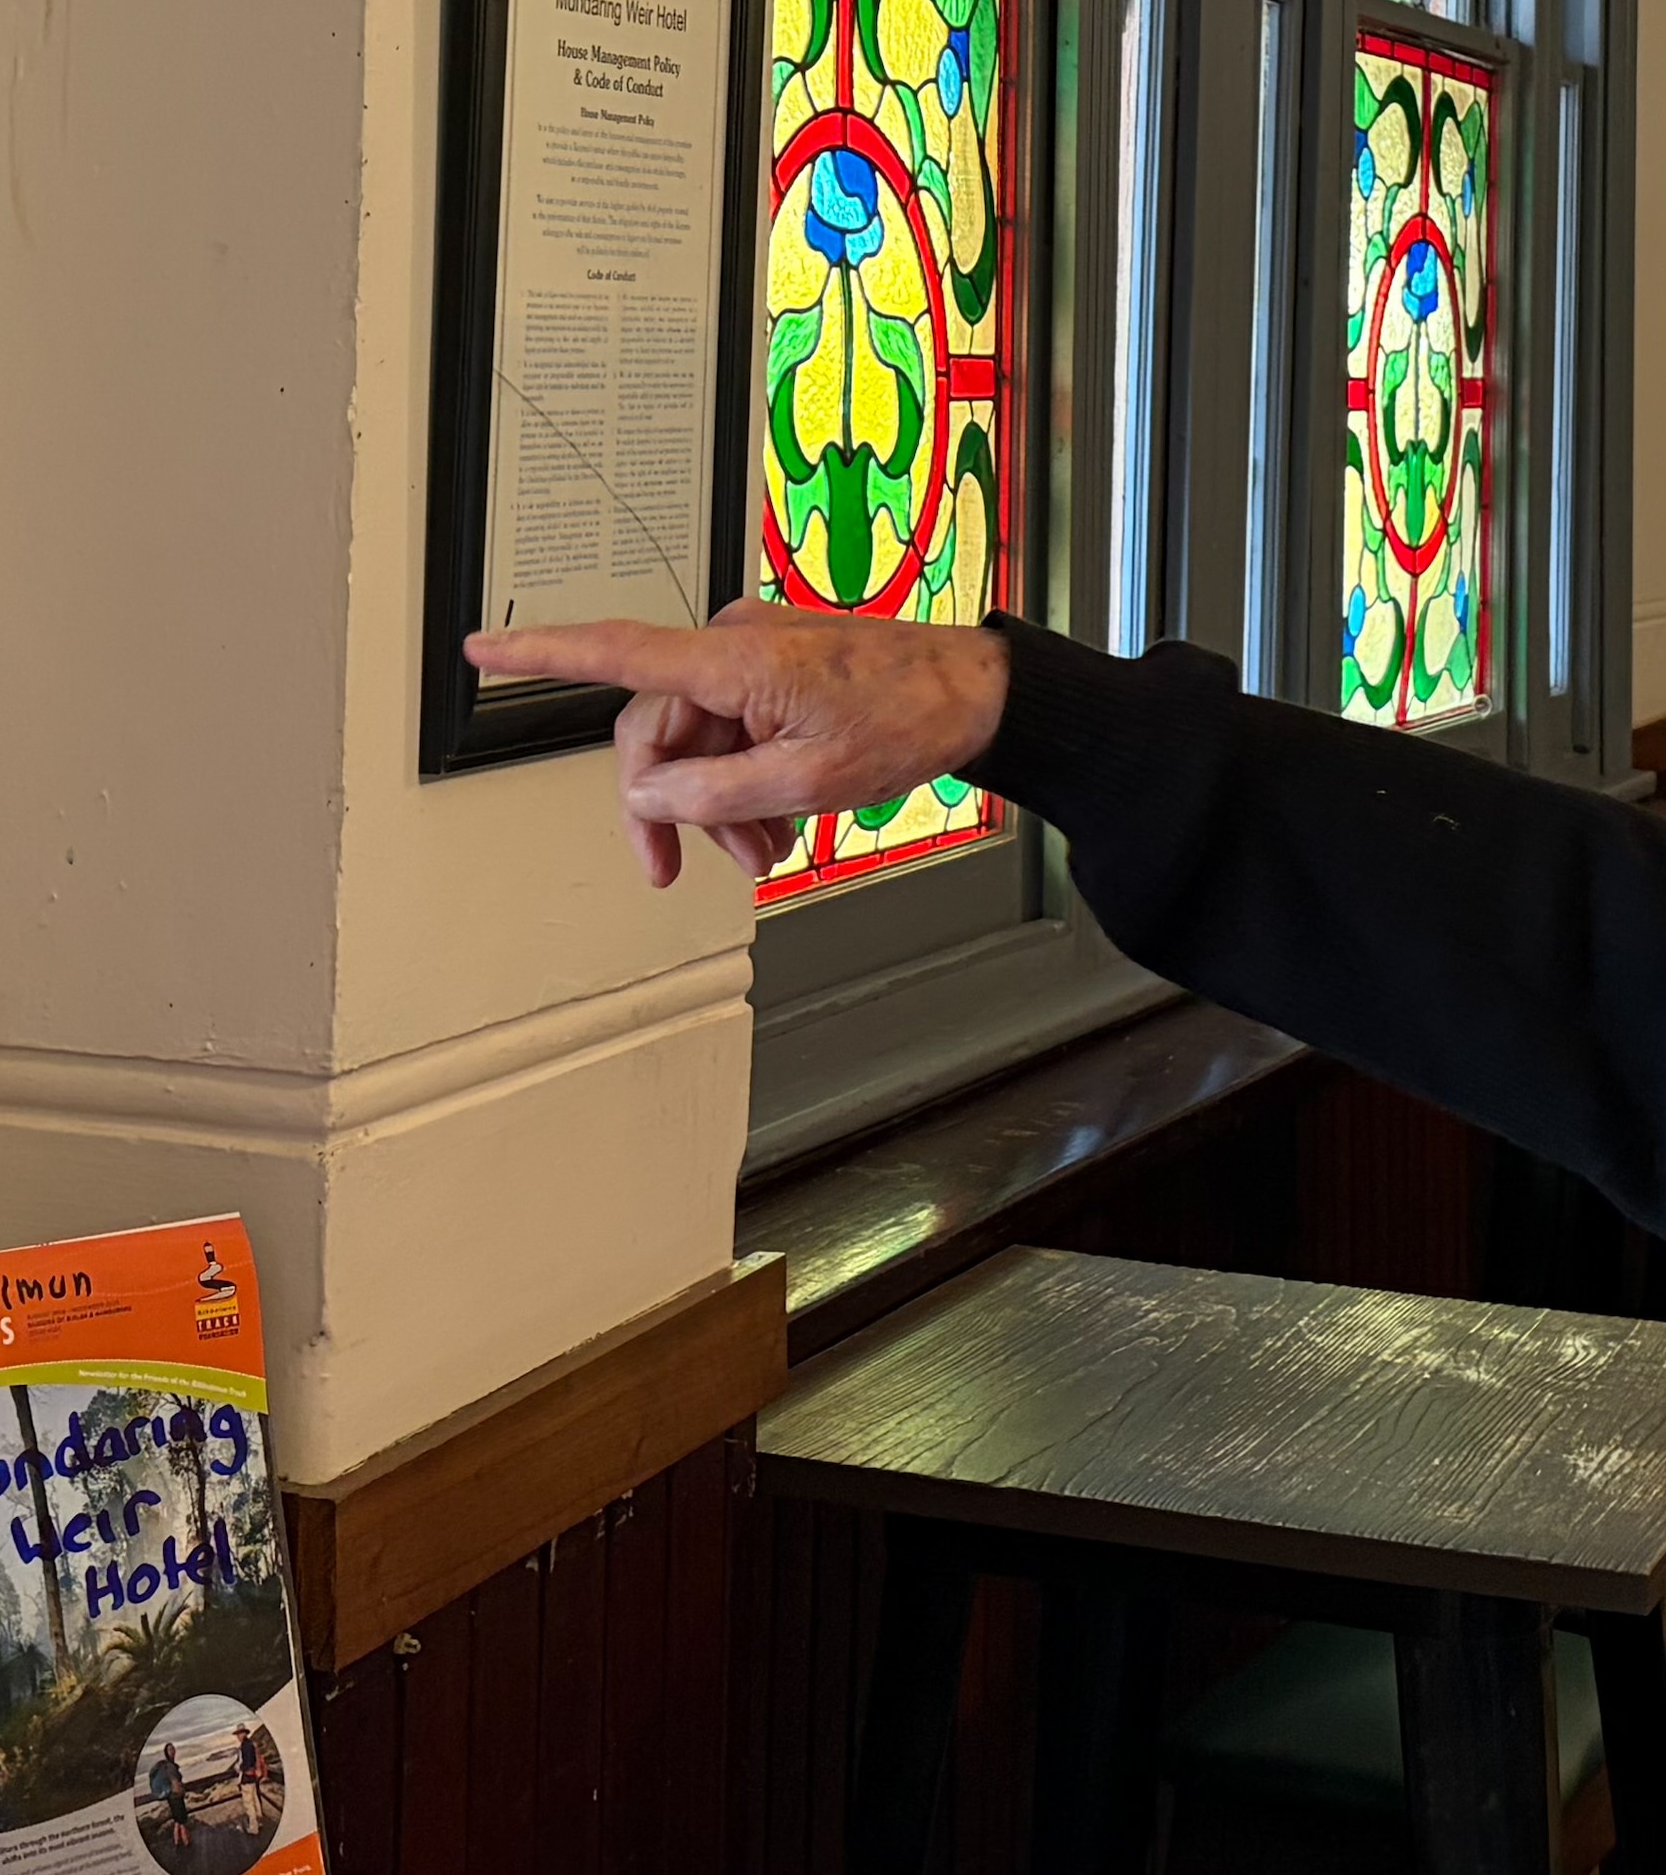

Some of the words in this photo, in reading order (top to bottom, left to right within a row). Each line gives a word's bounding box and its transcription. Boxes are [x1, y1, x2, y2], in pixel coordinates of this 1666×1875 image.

[626, 0, 654, 26] Weir
[656, 4, 687, 32] Hotel
[557, 39, 588, 60] House
[591, 45, 651, 70] Management
[654, 55, 681, 79] Policy
[573, 68, 582, 86] &
[585, 70, 611, 90] Code
[613, 75, 623, 92] of
[626, 76, 663, 97] Conduct
[580, 107, 598, 119] House
[601, 109, 636, 124] Management
[638, 114, 655, 129] Policy
[587, 269, 604, 281] Code
[605, 269, 611, 280] of
[612, 270, 636, 282] Conduct
[198, 1315, 238, 1331] TRACK
[10, 1490, 161, 1565] Weir
[85, 1515, 234, 1619] Hotel
